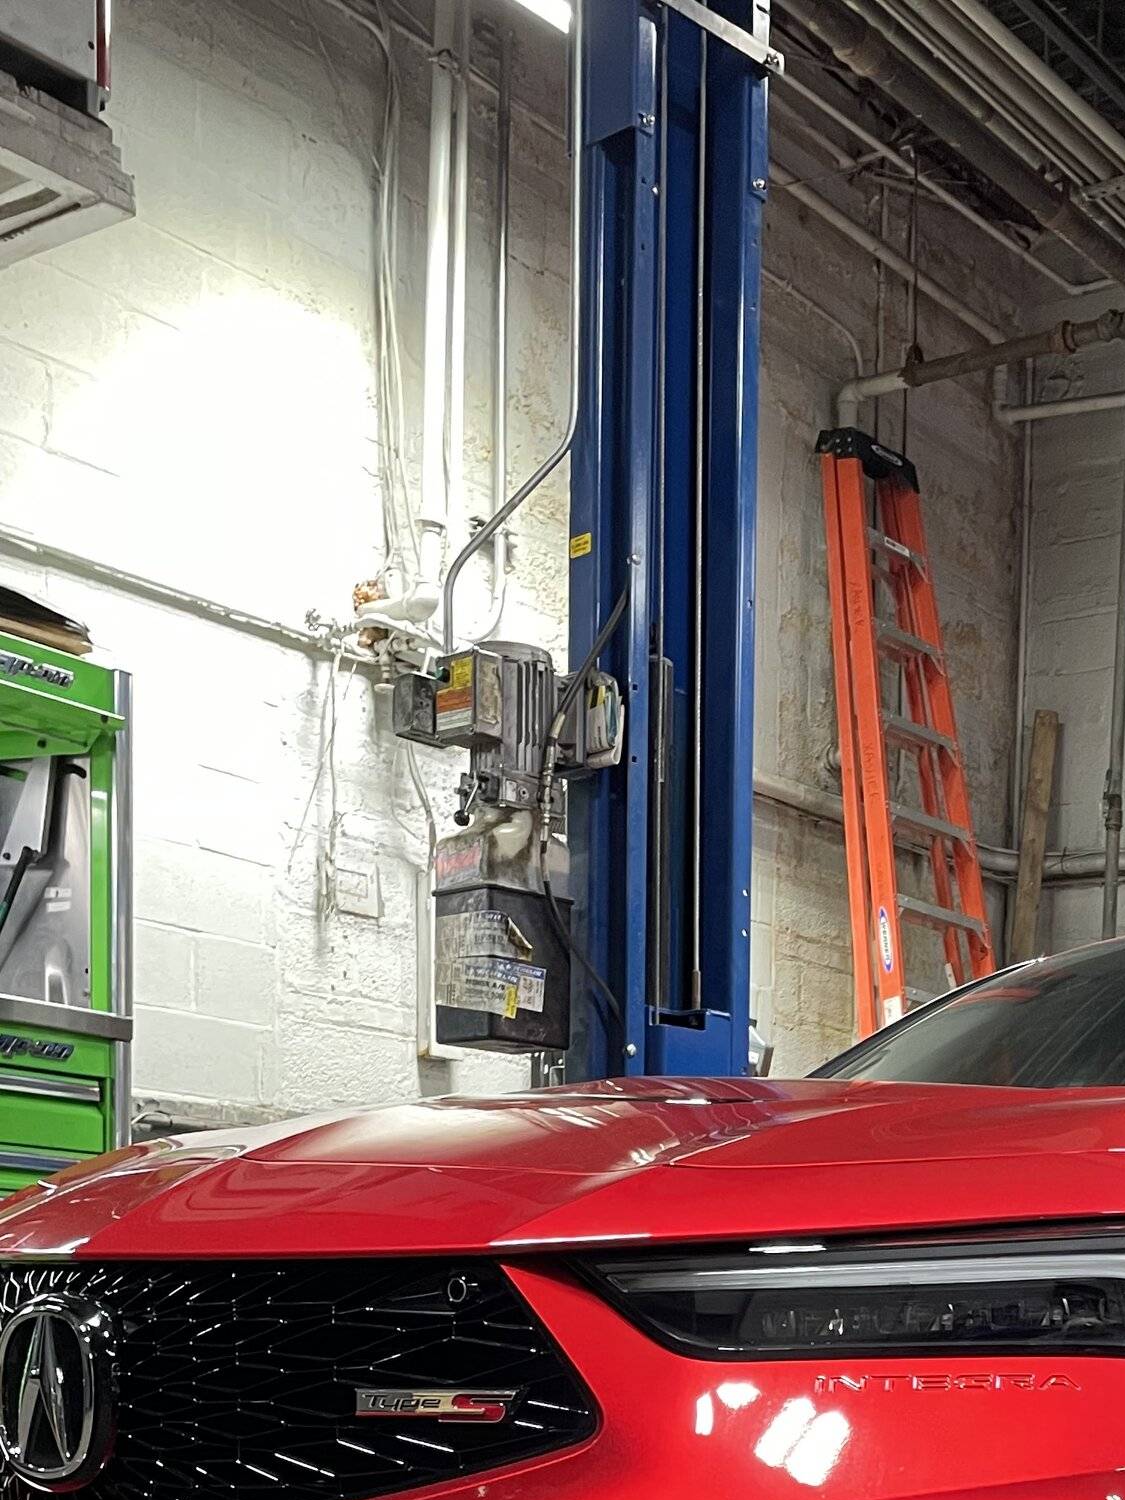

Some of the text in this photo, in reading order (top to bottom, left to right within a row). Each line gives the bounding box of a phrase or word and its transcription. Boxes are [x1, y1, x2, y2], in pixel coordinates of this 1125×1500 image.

[880, 921, 891, 961] WERNER
[814, 1373, 1082, 1393] INTEGRA
[362, 1392, 518, 1424] Type S
